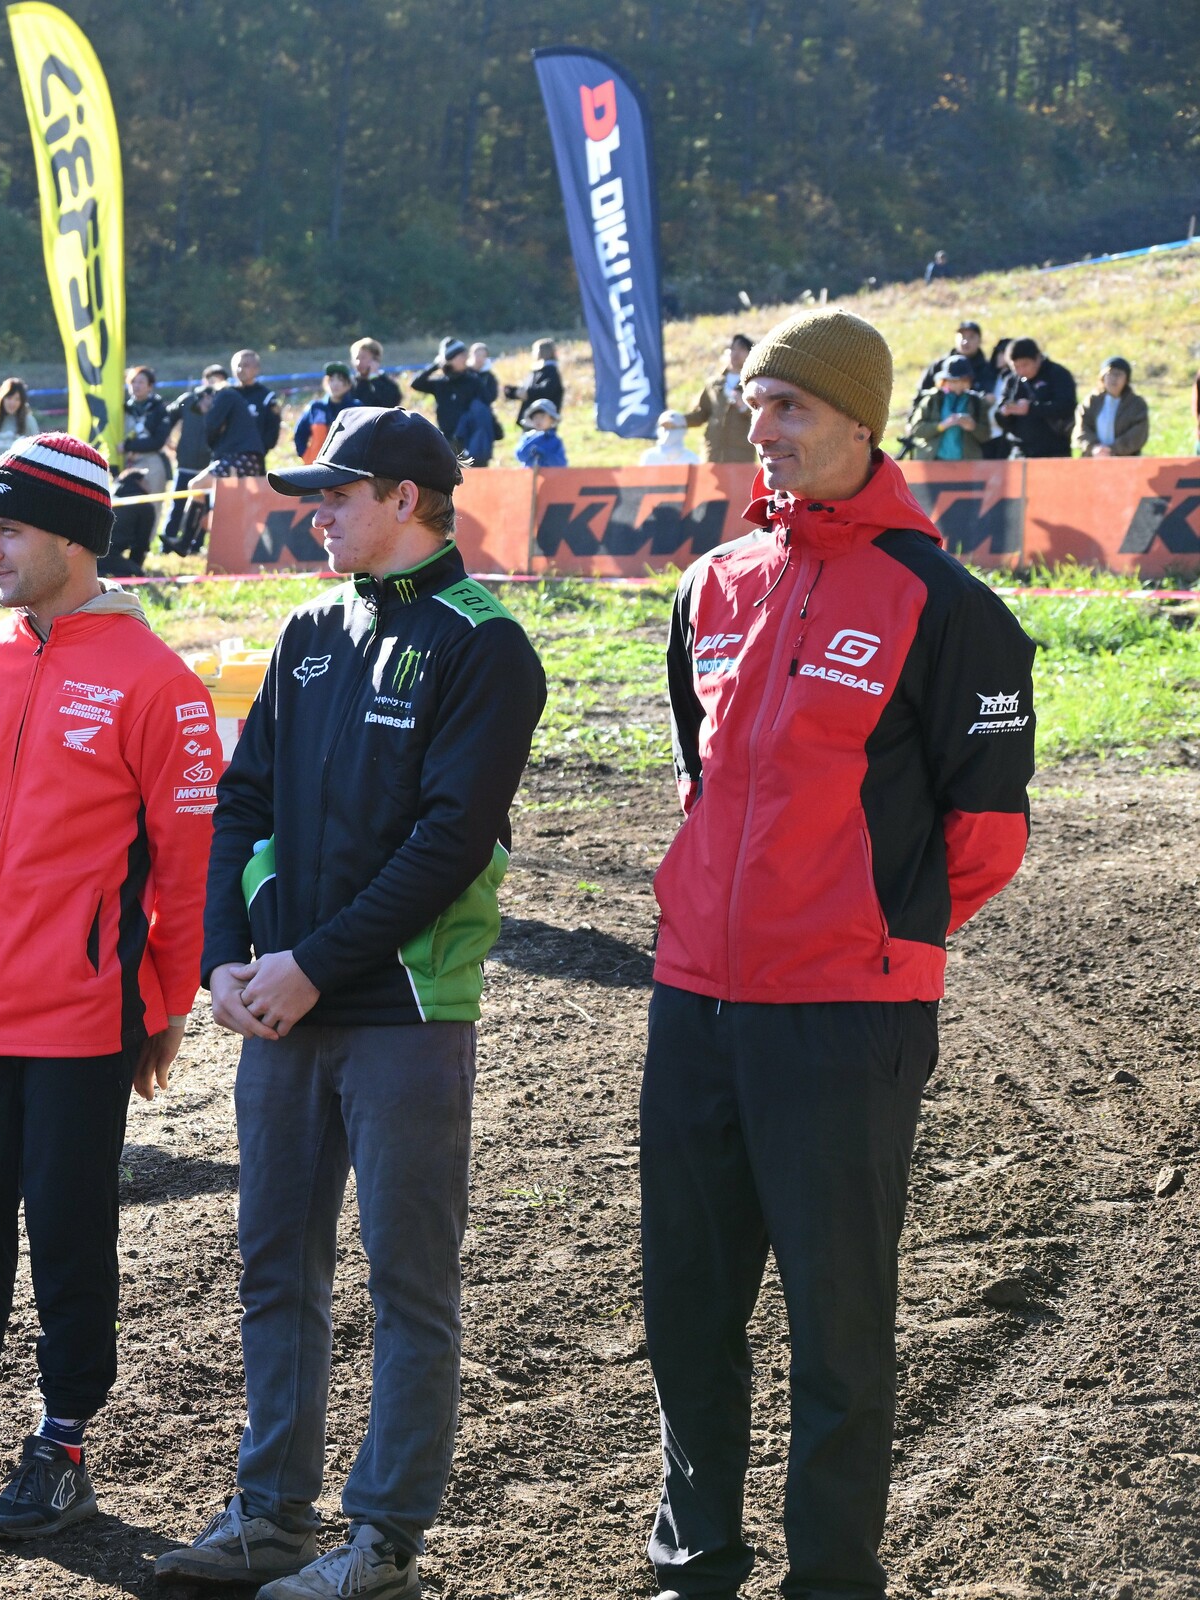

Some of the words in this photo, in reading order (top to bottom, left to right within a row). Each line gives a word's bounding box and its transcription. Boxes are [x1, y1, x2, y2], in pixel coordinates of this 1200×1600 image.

[534, 484, 730, 557] KTM
[907, 481, 1025, 555] TM
[452, 588, 494, 614] FOX
[695, 633, 744, 650] WP
[63, 680, 111, 696] PHOENIX
[800, 663, 885, 696] GASGAS
[373, 695, 412, 709] MONSTE
[982, 702, 1017, 713] KINI
[364, 710, 416, 729] Kawasaki
[967, 715, 1029, 735] pankl
[62, 741, 96, 755] HONDA
